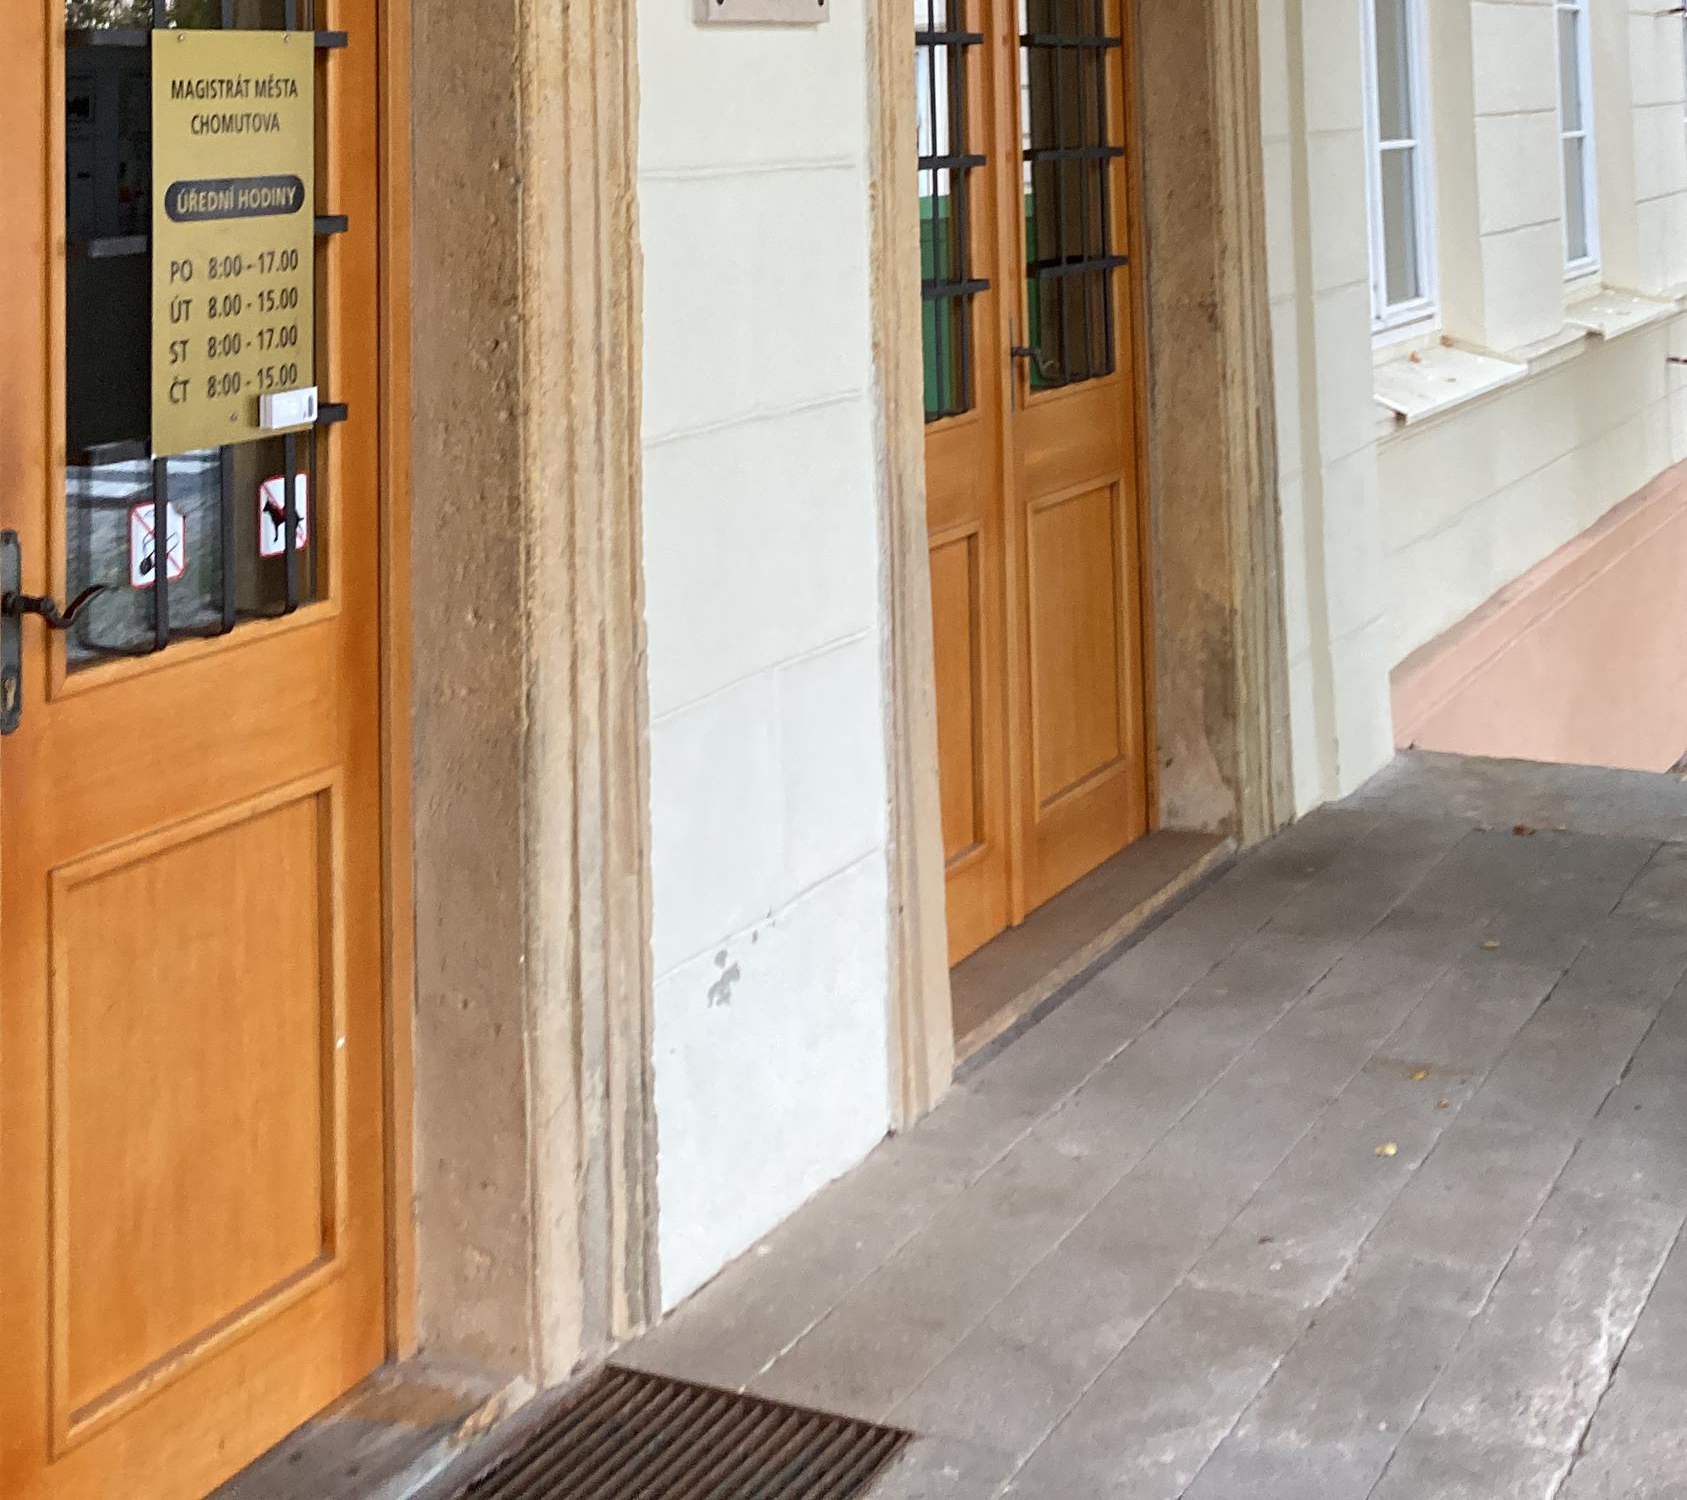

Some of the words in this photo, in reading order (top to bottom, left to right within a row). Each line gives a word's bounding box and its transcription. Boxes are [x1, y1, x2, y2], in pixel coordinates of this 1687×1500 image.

[171, 72, 250, 100] MAGISTRÁT
[254, 72, 299, 98] MĚSTA
[191, 112, 281, 135] CHOMUTOVA
[176, 185, 236, 215] ÚŘEDNÍ
[238, 185, 297, 210] HODINY
[170, 258, 193, 284] PO
[258, 248, 299, 274] 17.00
[170, 294, 193, 324] ÚT
[258, 286, 298, 312] 15.00
[169, 338, 191, 365] ST
[258, 325, 298, 350] 17.00
[169, 373, 191, 404] ČT
[257, 362, 297, 389] 15.00
